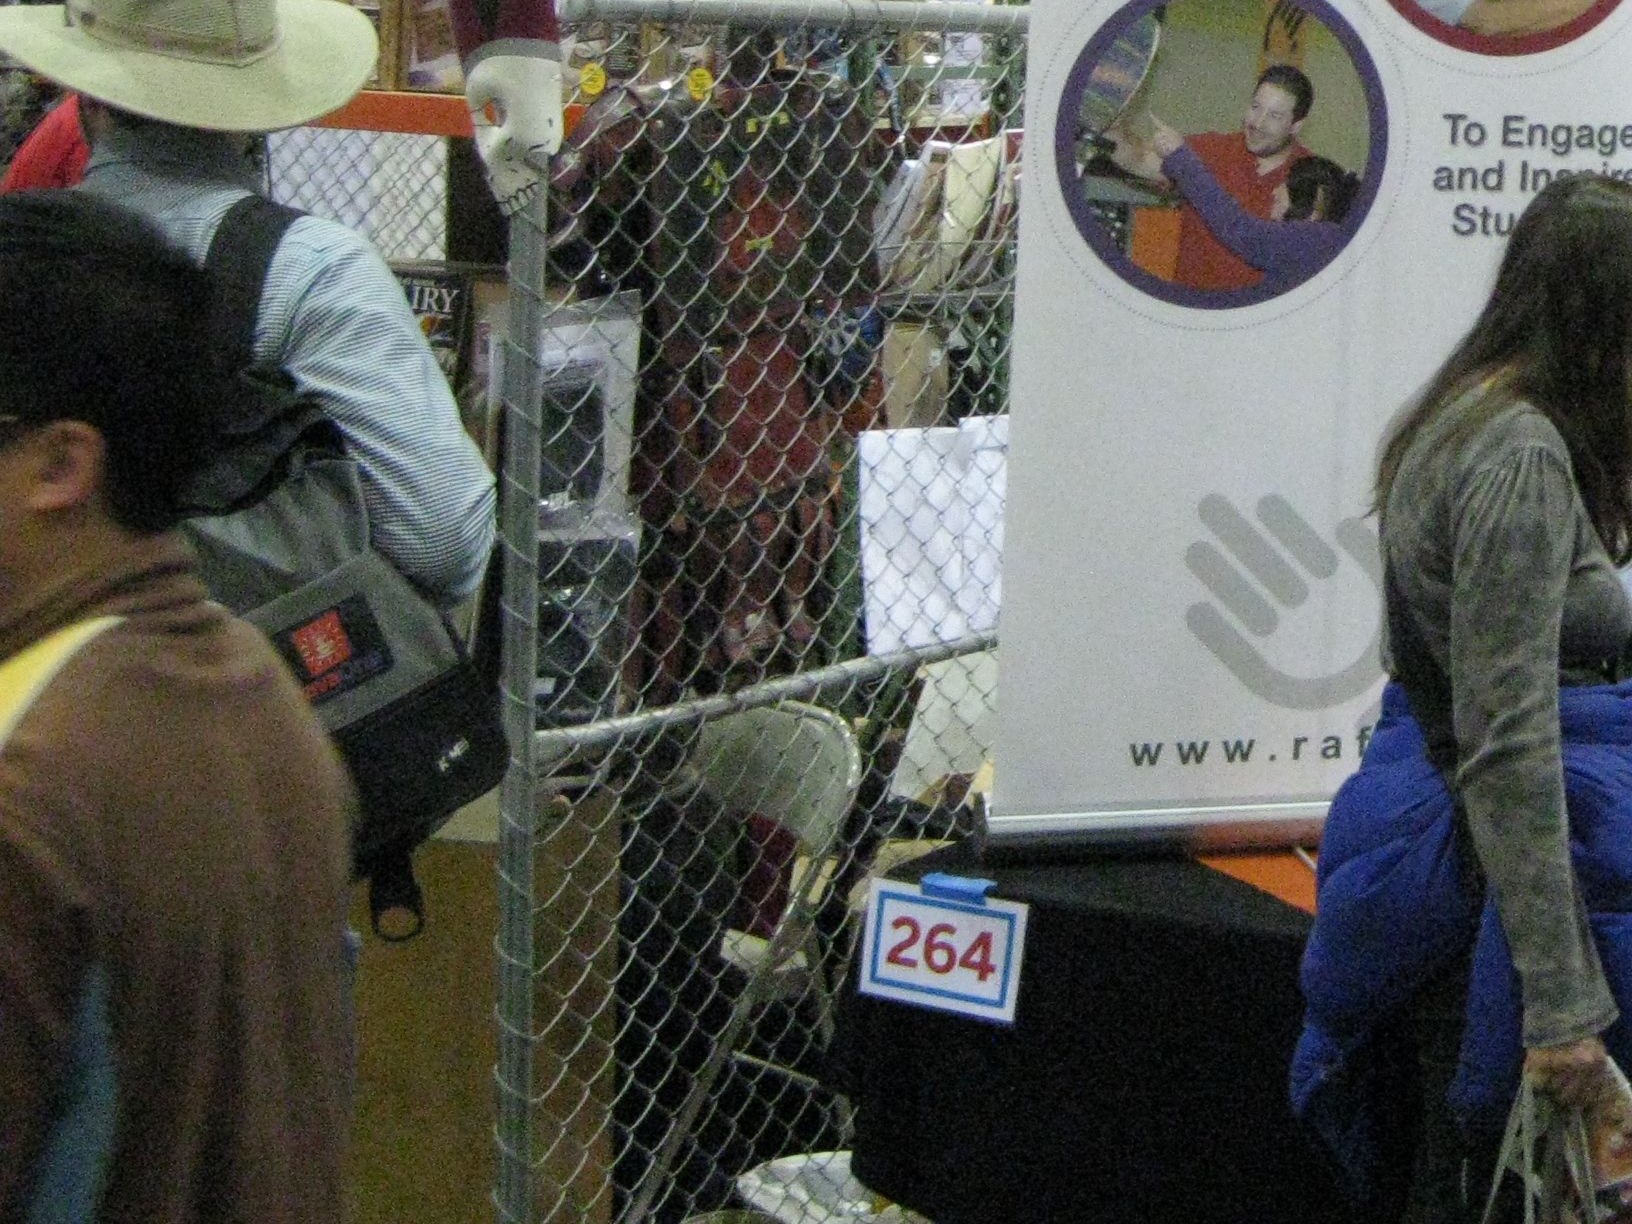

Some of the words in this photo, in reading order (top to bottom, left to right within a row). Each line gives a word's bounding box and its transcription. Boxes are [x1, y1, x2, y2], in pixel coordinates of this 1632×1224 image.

[1443, 113, 1487, 147] To
[1433, 160, 1505, 192] and
[886, 916, 997, 982] 264
